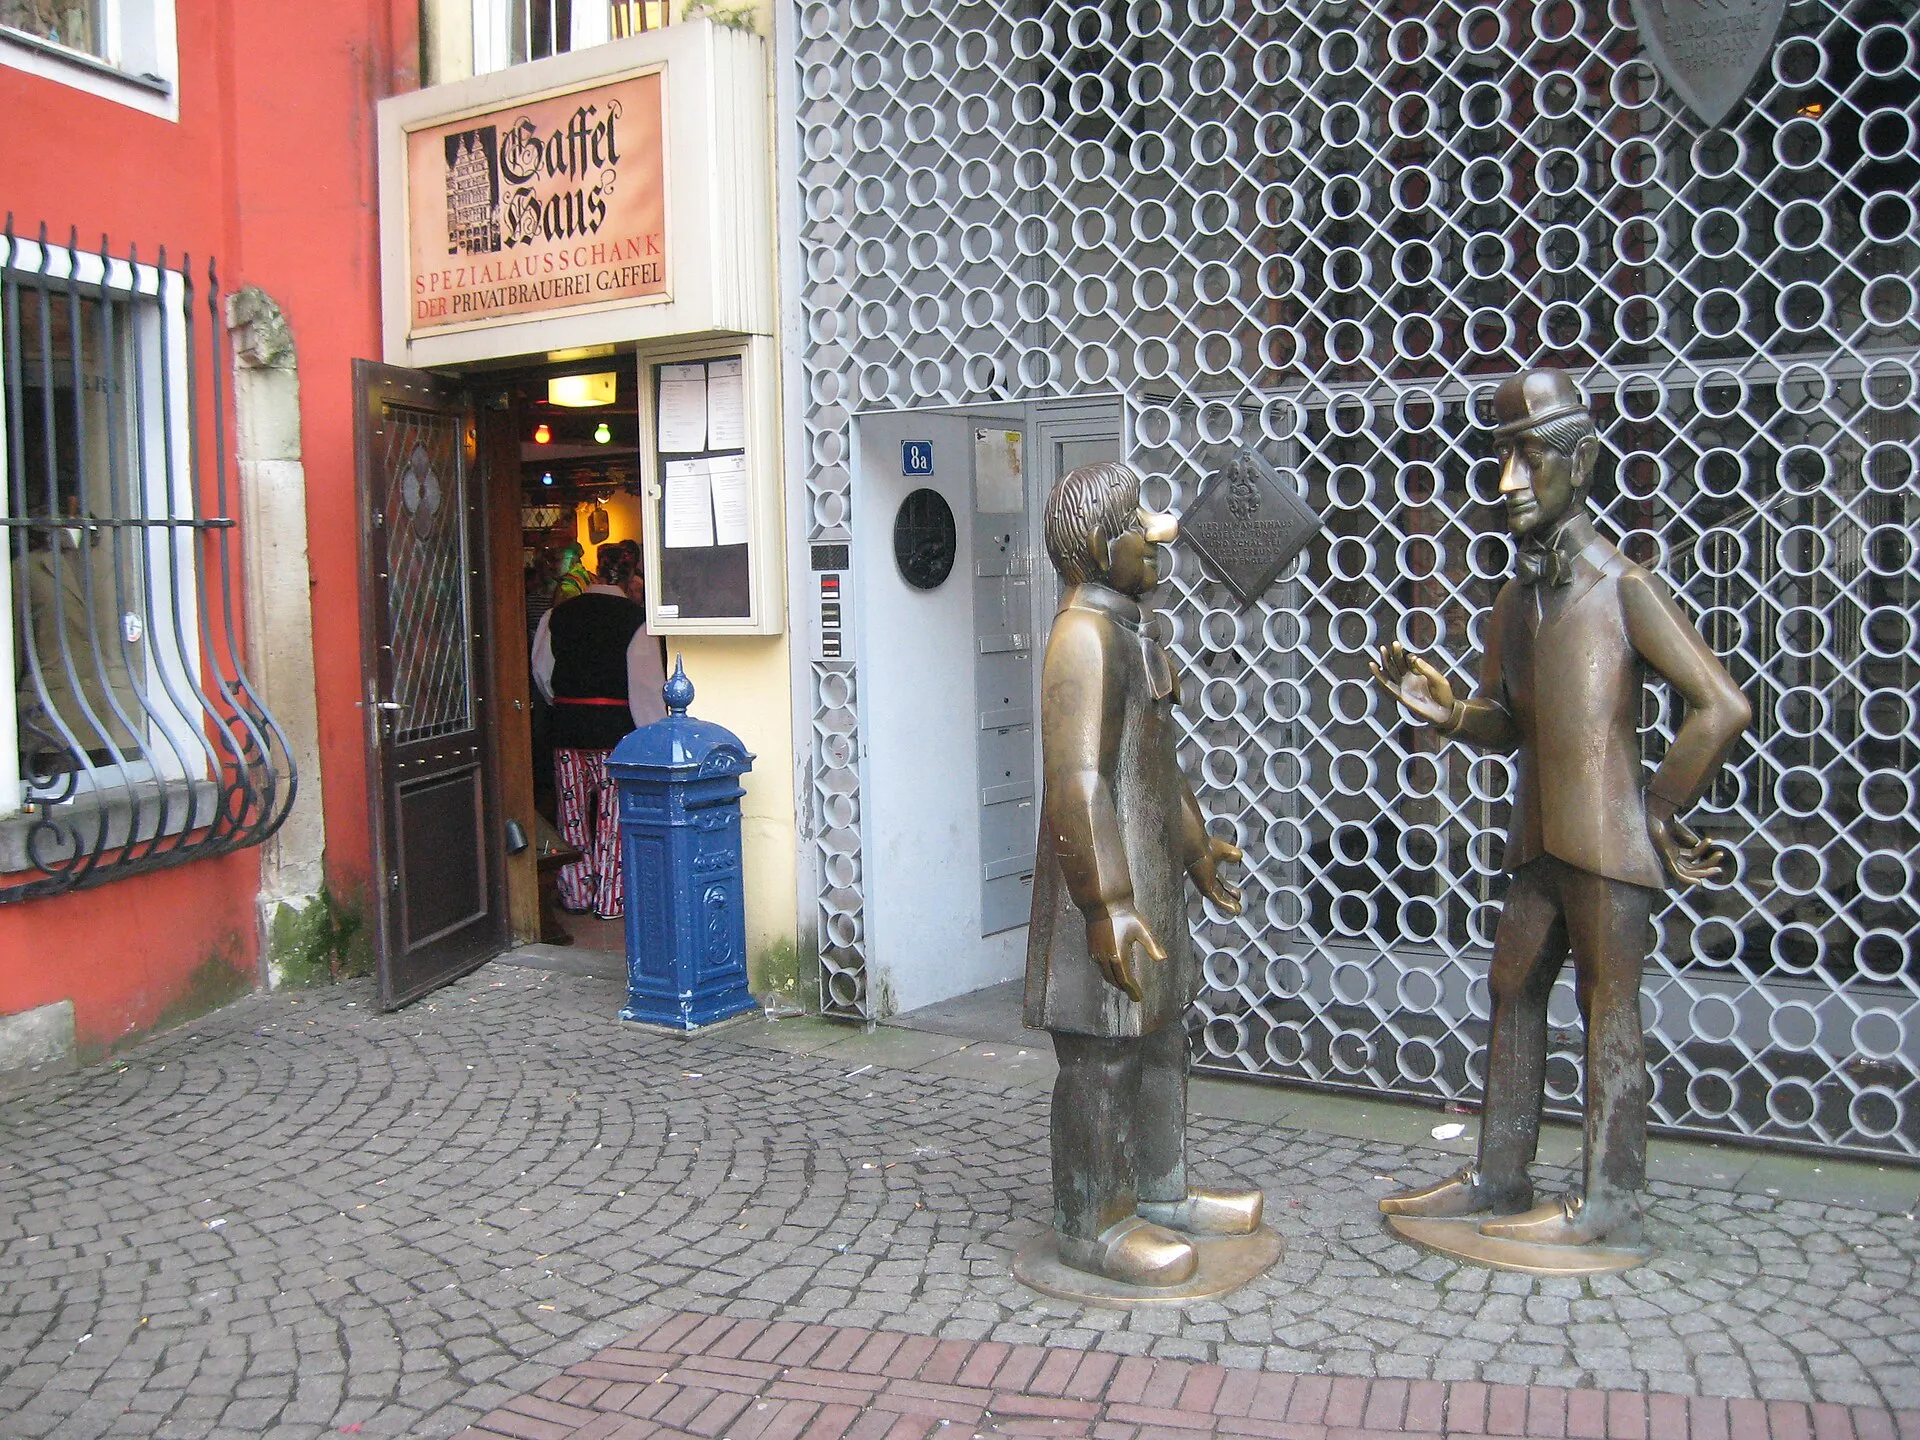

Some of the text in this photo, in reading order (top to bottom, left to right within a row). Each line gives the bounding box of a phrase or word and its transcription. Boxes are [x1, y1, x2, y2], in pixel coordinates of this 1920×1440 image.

[500, 98, 623, 185] Gaffel
[503, 168, 616, 249] Haus
[415, 232, 661, 295] SPEZIALAUSSCHANK
[416, 262, 662, 320] DER PRIVATBRAUEREI GAFFEL
[911, 446, 927, 469] 8a
